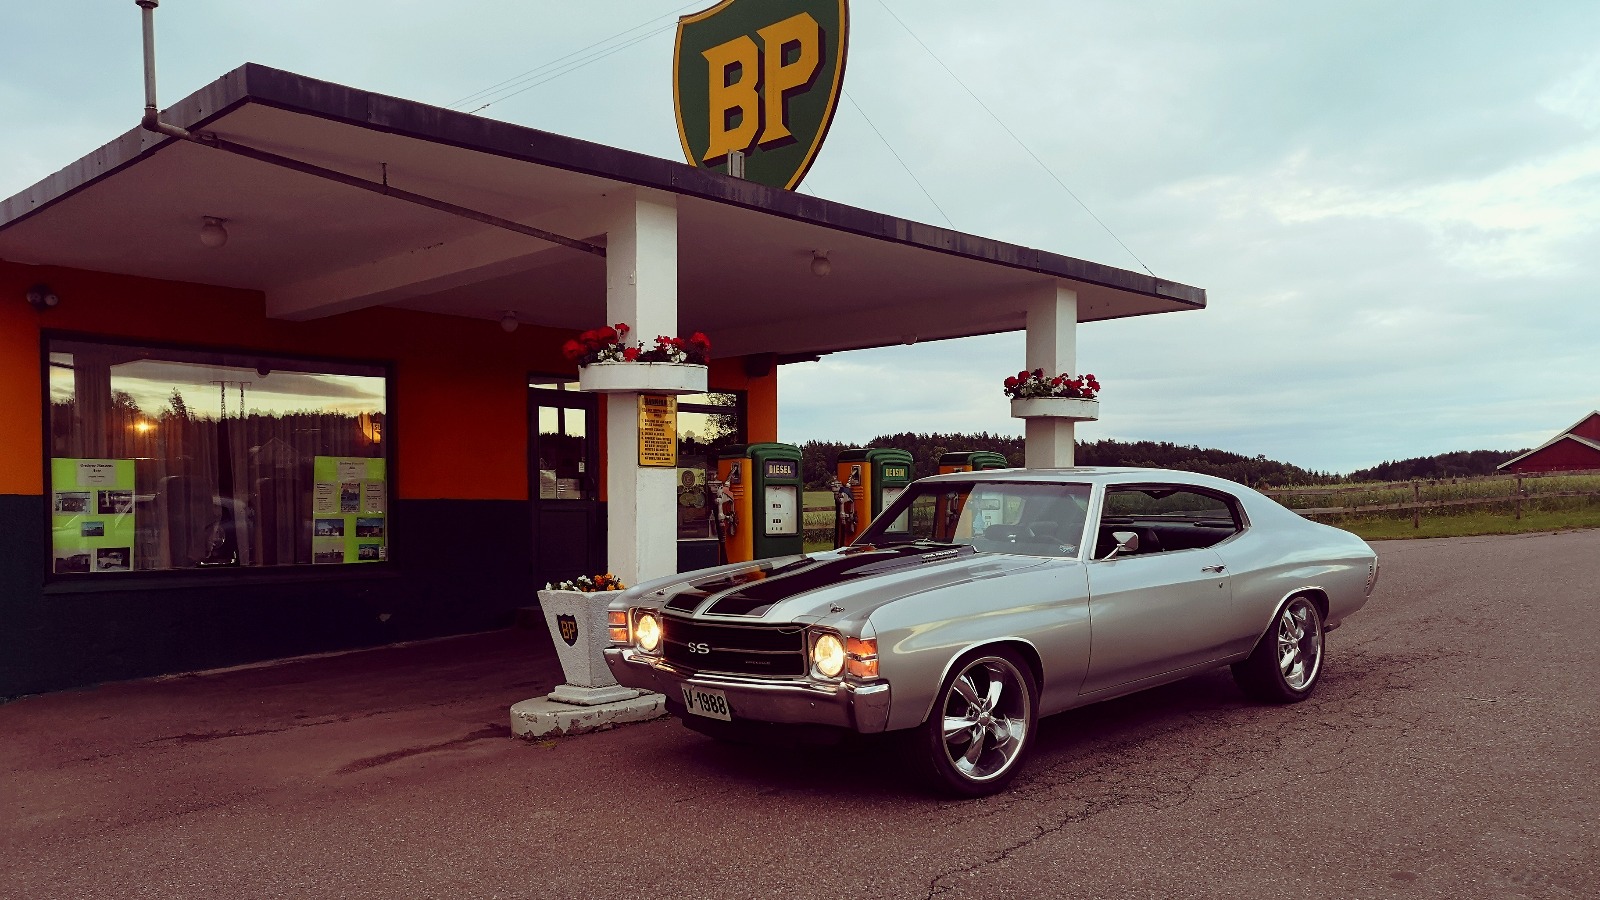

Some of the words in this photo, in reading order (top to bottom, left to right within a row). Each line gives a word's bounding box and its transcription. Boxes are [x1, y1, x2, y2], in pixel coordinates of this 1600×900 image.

[701, 11, 823, 163] BP
[768, 464, 792, 474] DIESEL
[885, 468, 905, 477] BENSIN
[561, 620, 576, 640] BP
[688, 641, 710, 654] SS
[682, 689, 727, 716] V-1988
